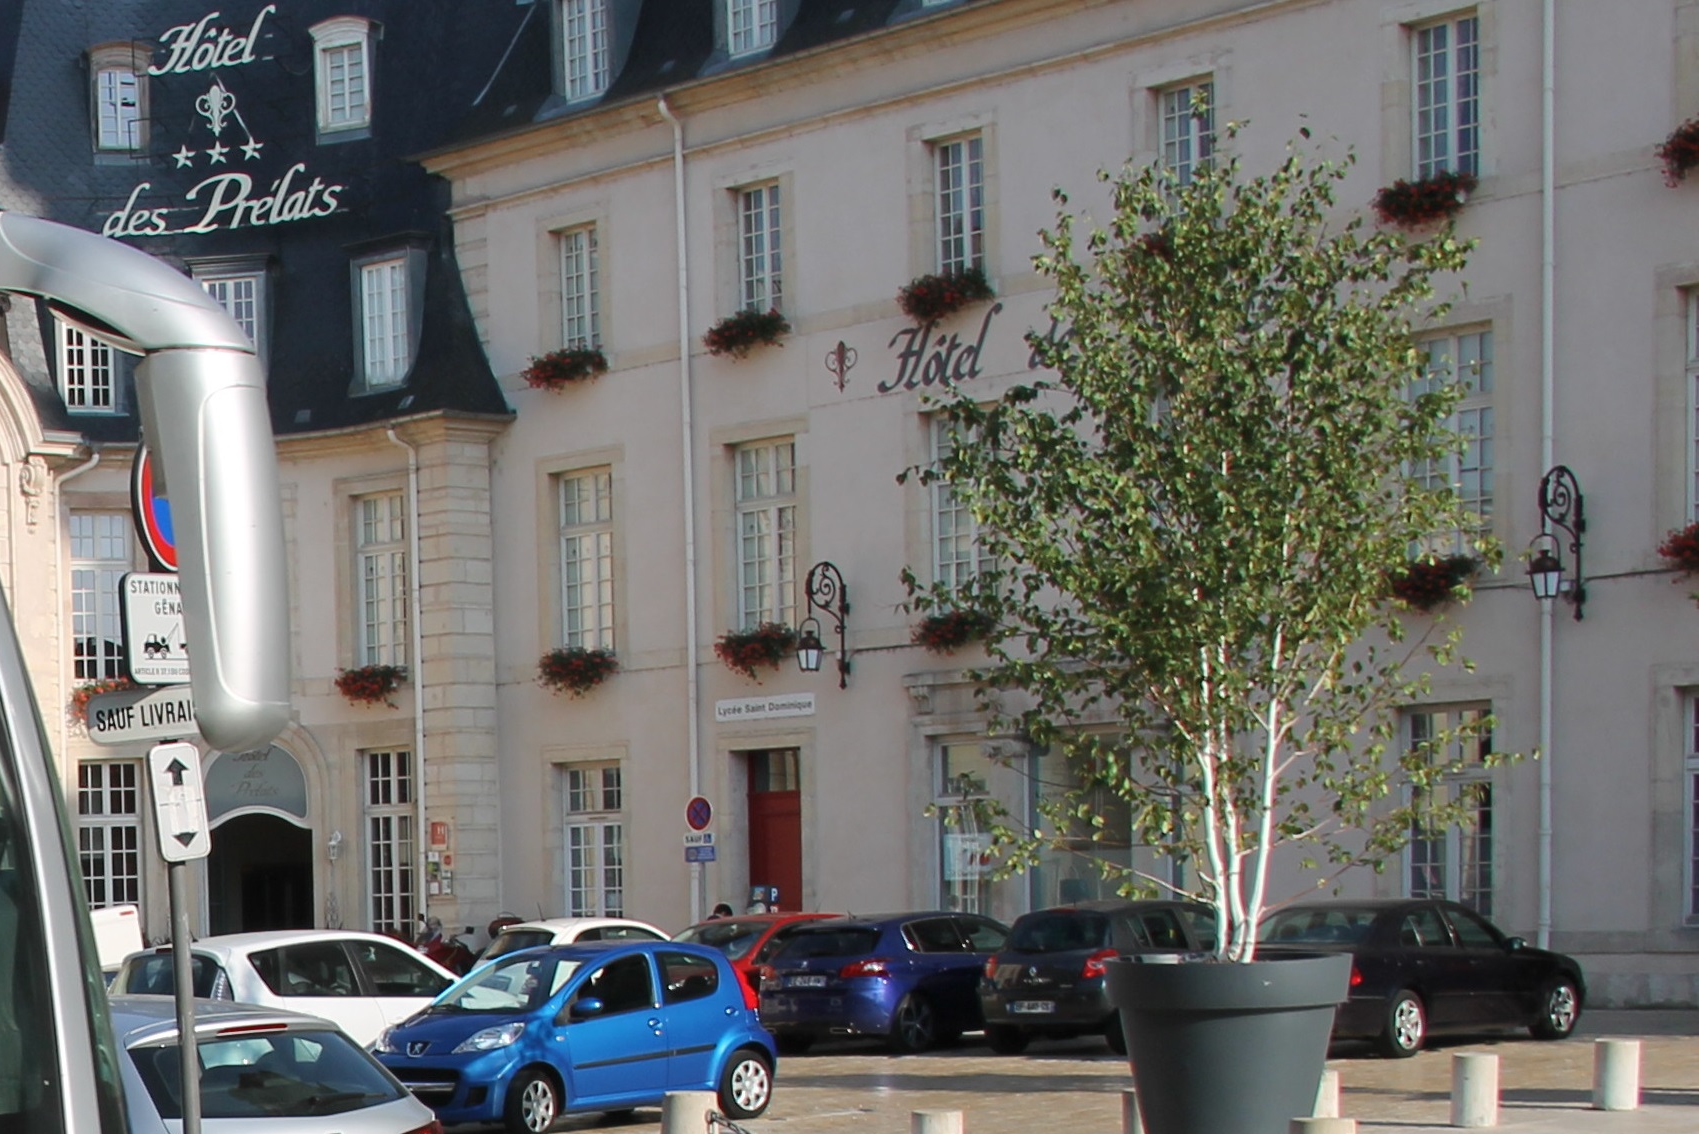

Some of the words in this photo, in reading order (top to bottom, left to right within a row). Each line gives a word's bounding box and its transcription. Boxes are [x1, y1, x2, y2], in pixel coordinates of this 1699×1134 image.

[148, 5, 276, 76] Hôtel
[102, 183, 169, 238] des
[184, 163, 343, 234] Prélats
[877, 302, 1003, 394] Hôtel
[96, 706, 135, 732] SAUF
[140, 699, 195, 727] LIVRAI
[717, 706, 742, 717] Lycée
[745, 703, 766, 713] Saint
[768, 701, 813, 712] Dominique
